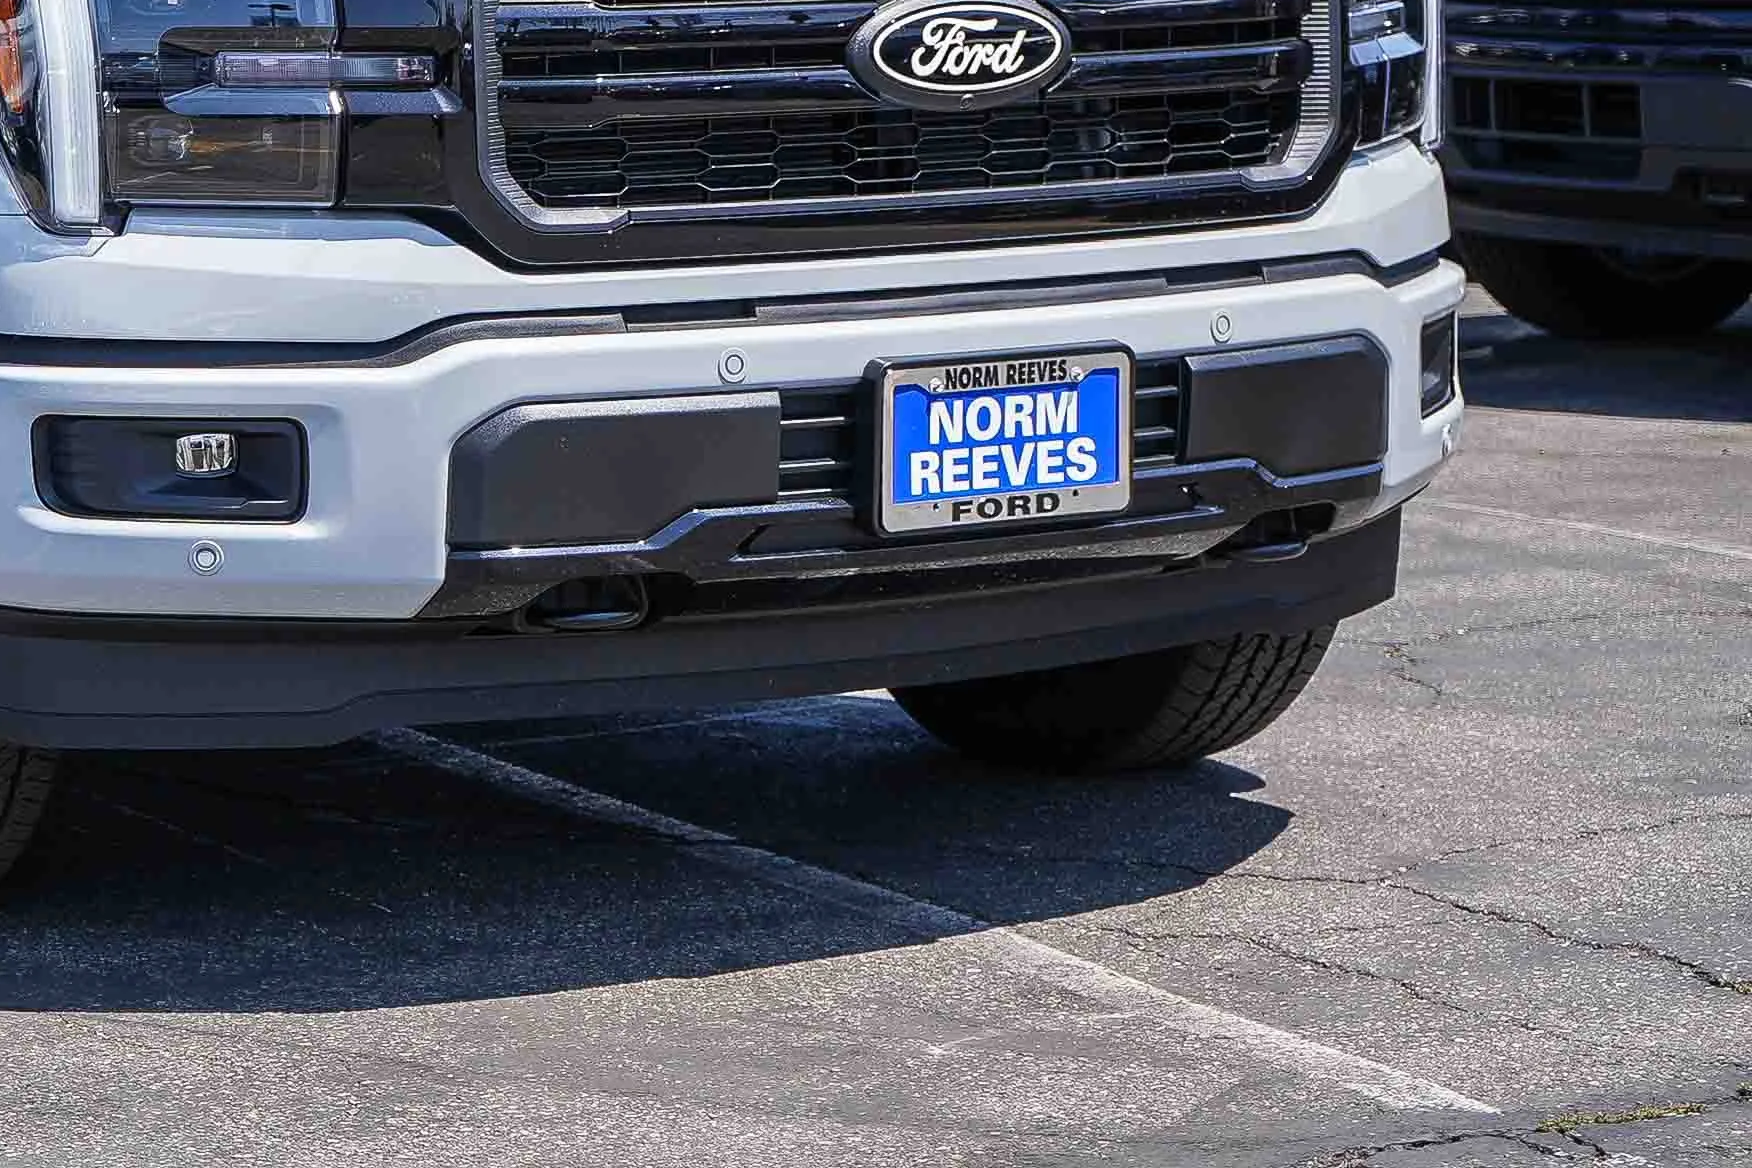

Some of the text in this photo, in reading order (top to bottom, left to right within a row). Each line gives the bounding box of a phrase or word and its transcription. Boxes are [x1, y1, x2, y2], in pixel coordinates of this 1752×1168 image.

[912, 17, 1027, 77] Ford
[945, 359, 1068, 390] NORM REEVES
[929, 391, 1078, 445] NORM
[910, 437, 1097, 496] REEVES
[951, 492, 1060, 522] FORD
